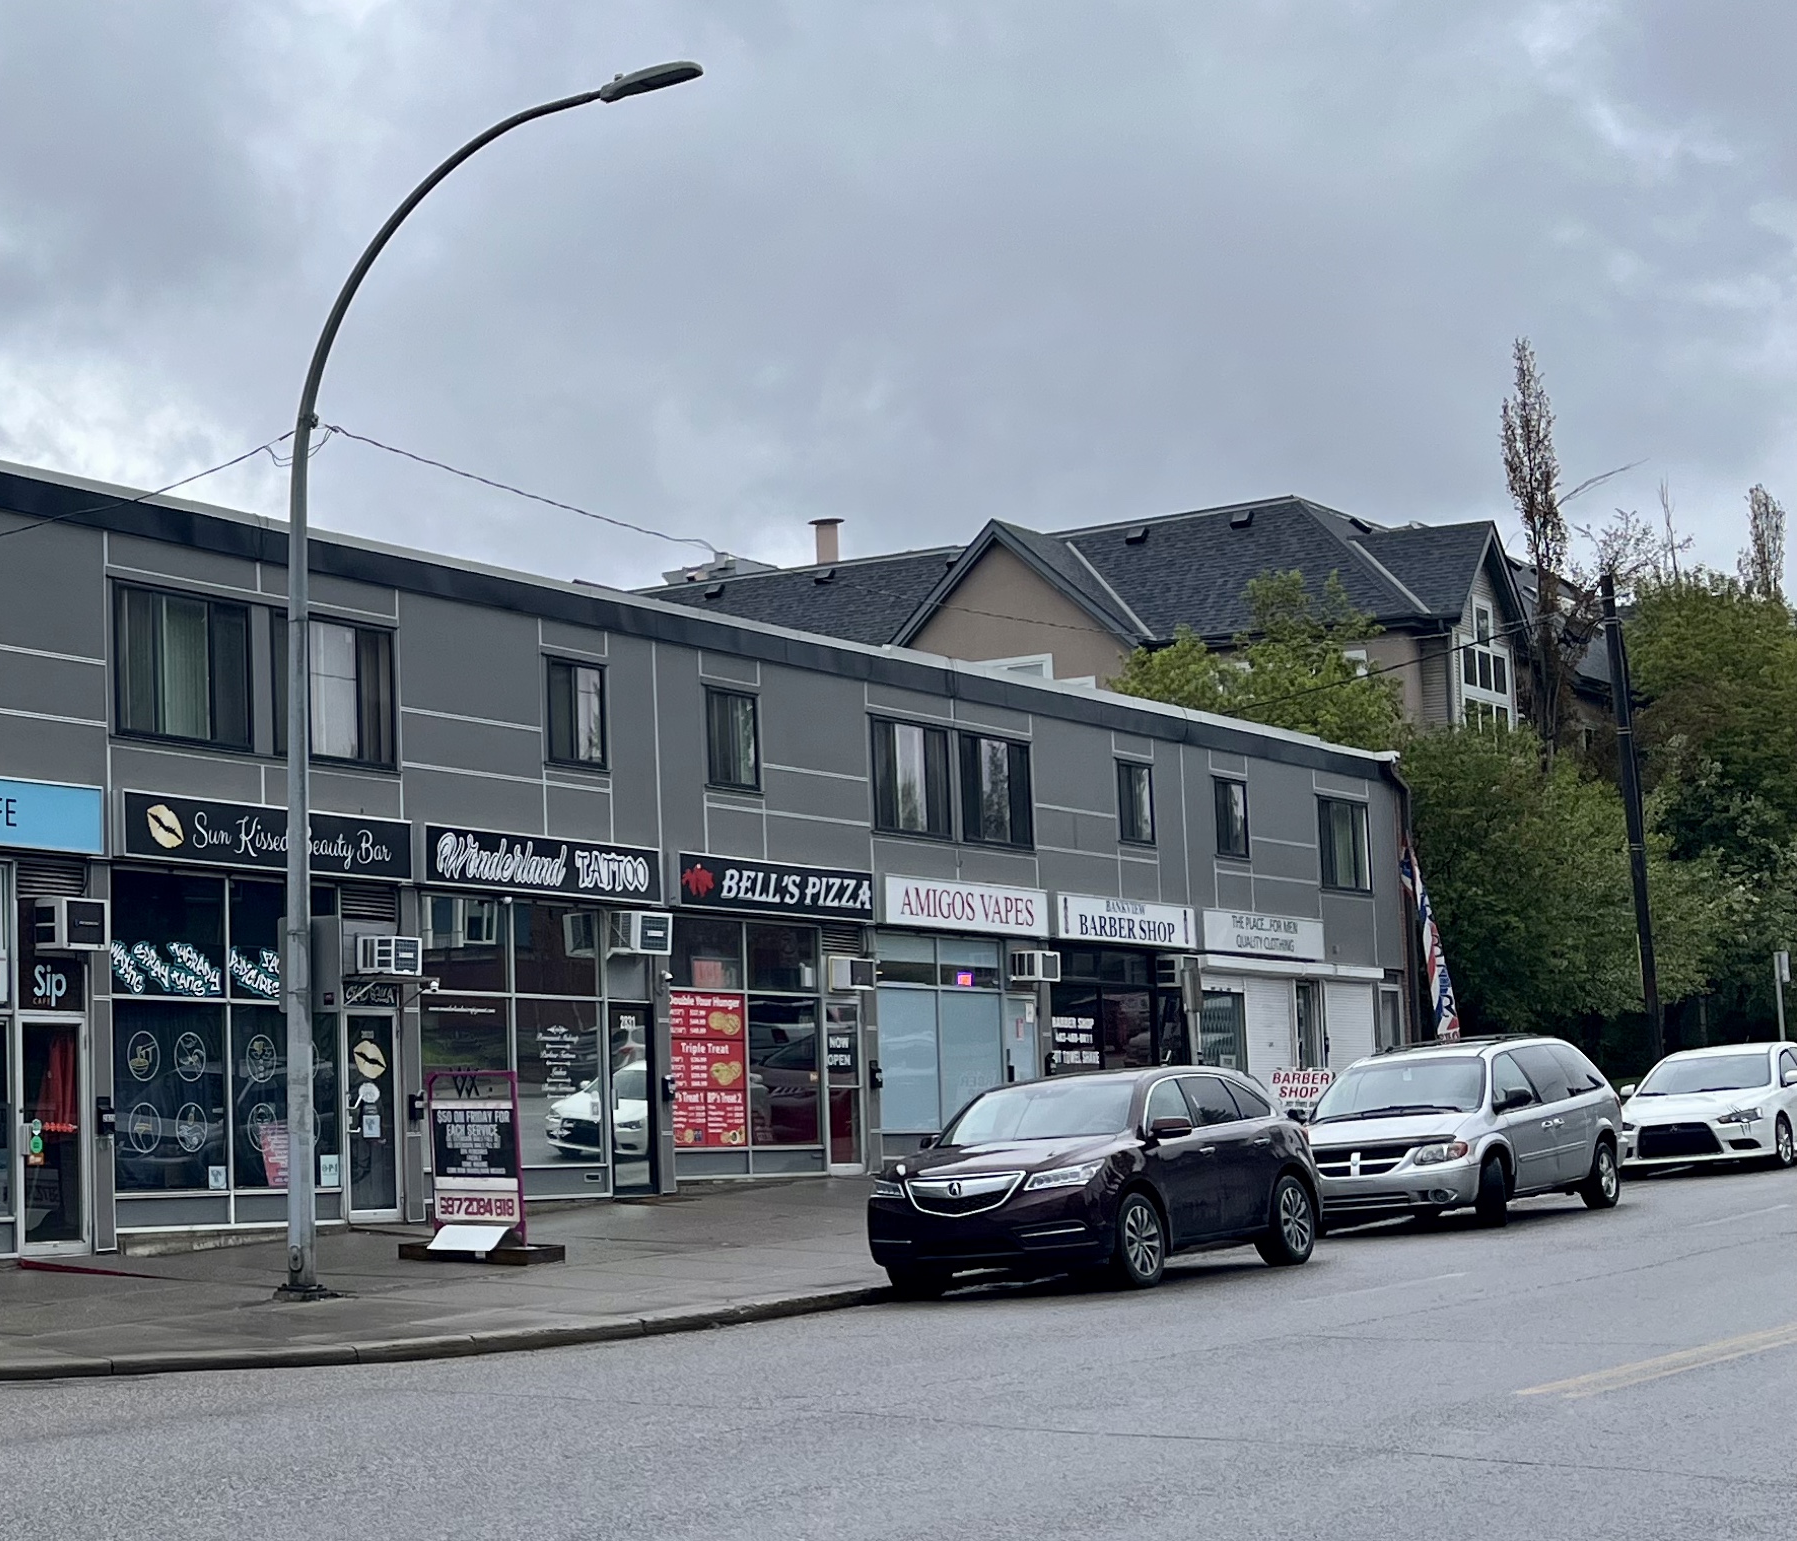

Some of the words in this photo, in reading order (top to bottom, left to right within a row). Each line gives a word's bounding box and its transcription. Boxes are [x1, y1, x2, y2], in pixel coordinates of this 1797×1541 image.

[193, 811, 232, 848] Sun
[356, 829, 392, 864] Bar
[436, 832, 567, 887] Wonderland
[575, 850, 649, 892] TATTOO
[720, 868, 801, 905] BELL'S
[804, 876, 872, 909] PIZZA
[900, 886, 976, 921] AMIGOS
[980, 894, 1035, 927] VAPES
[1105, 900, 1147, 915] BANKVIEW
[1078, 914, 1137, 940] BARBER
[1139, 919, 1175, 943] SHOP
[33, 964, 67, 1007] Sip
[681, 1042, 706, 1056] Triple
[707, 1043, 730, 1055] Treat
[829, 1036, 849, 1048] NOW
[827, 1054, 851, 1066] OPEN
[1272, 1072, 1330, 1085] BARBER
[1279, 1086, 1319, 1098] SHOP
